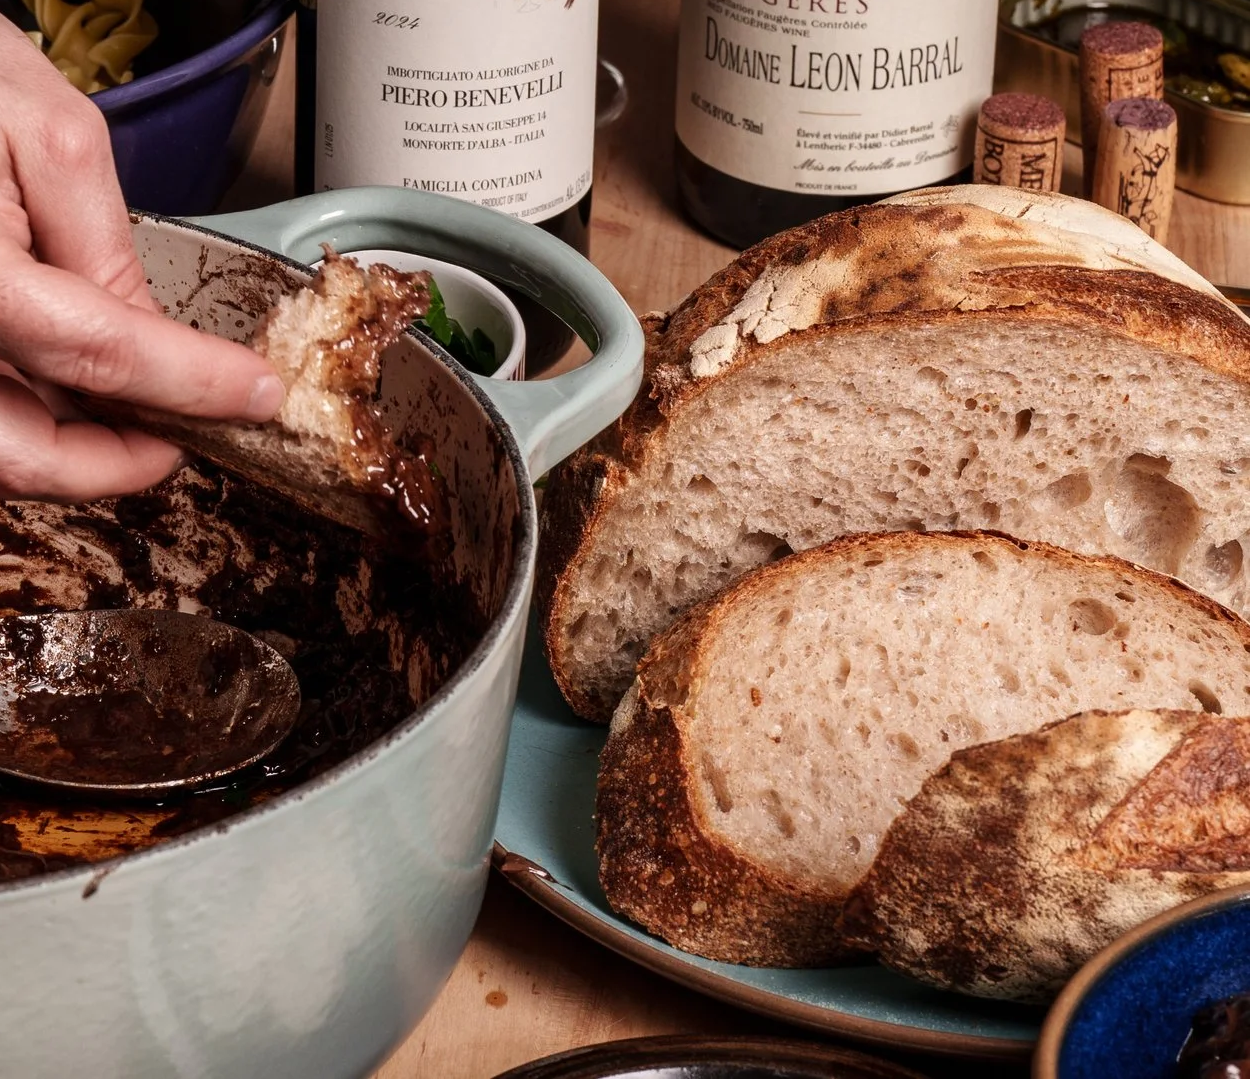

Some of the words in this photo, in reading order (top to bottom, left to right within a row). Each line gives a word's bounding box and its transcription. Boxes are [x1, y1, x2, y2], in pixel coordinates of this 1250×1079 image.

[372, 11, 421, 30] 2024
[757, 9, 807, 28] Faugères
[810, 19, 868, 31] Contrôlée
[781, 25, 811, 39] WINE
[387, 65, 474, 82] IMBOTTIGLIATO
[541, 56, 554, 69] DA
[380, 83, 448, 109] PIERO
[453, 70, 565, 109] BENEVELLI
[404, 119, 460, 134] LOCALITÀ
[461, 122, 484, 134] SAN
[486, 113, 536, 131] GIUSEPPE
[537, 110, 547, 121] 14
[823, 129, 832, 140] et
[864, 130, 879, 142] par
[881, 126, 908, 139] Didier
[910, 121, 934, 135] Barral
[402, 137, 466, 152] MONFORTE
[467, 138, 507, 151] D'ALBA
[514, 129, 546, 146] ITALIA
[403, 177, 468, 193] FAMIGLIA
[471, 168, 543, 193] CONTADINA
[482, 195, 507, 208] PRODUCT
[507, 193, 515, 205] OF
[515, 192, 529, 203] ITALY
